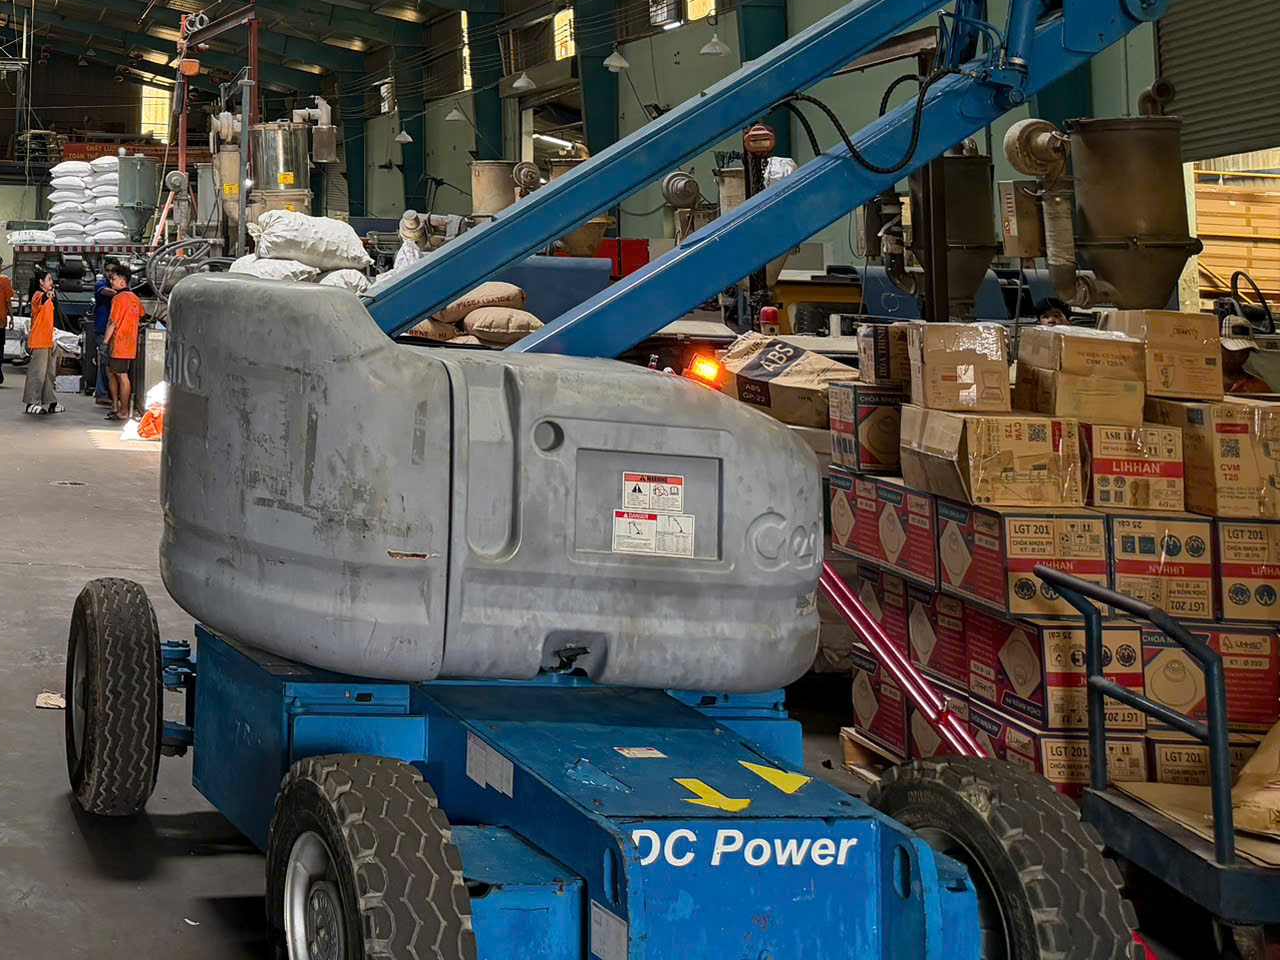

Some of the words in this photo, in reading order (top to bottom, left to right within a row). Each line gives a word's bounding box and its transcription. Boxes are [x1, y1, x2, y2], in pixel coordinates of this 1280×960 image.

[760, 344, 794, 372] ABS
[1112, 461, 1160, 473] LIHHAN
[1220, 464, 1240, 472] CVM
[1014, 524, 1031, 535] LGT
[1034, 524, 1050, 535] 201
[1228, 530, 1245, 539] LGT
[1248, 530, 1264, 540] 201
[1171, 600, 1186, 610] 201
[1188, 602, 1204, 612] LGT
[1121, 712, 1138, 722] LGT
[1050, 746, 1068, 756] LGT
[1071, 746, 1088, 757] 201
[1165, 752, 1182, 762] LGT
[1186, 752, 1202, 763] 201
[632, 829, 697, 866] DC
[711, 829, 858, 866] Power
